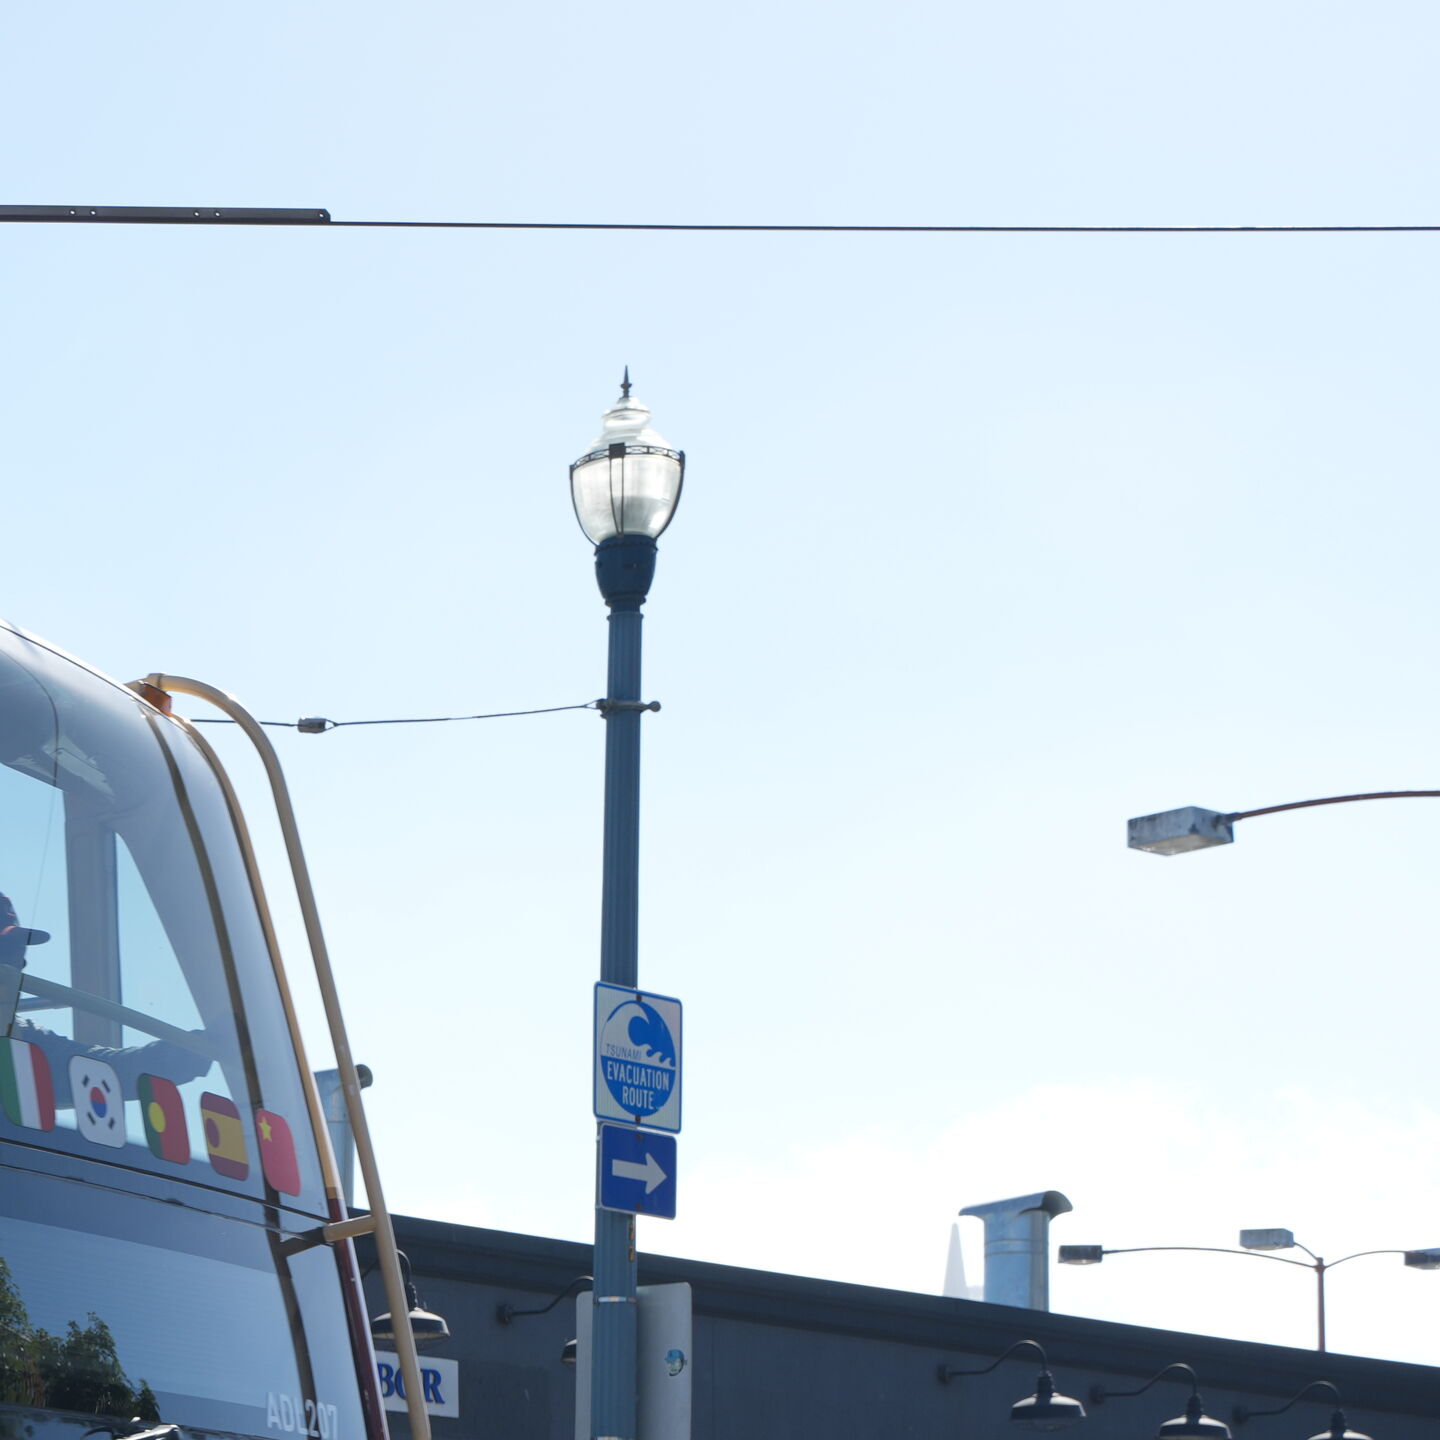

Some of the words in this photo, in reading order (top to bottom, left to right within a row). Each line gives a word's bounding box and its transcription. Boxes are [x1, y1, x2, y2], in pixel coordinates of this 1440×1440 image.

[606, 1043, 642, 1060] TSUNAMI
[607, 1061, 669, 1091] EVACUATION
[622, 1085, 654, 1110] ROUTE
[265, 1391, 338, 1440] ADL207
